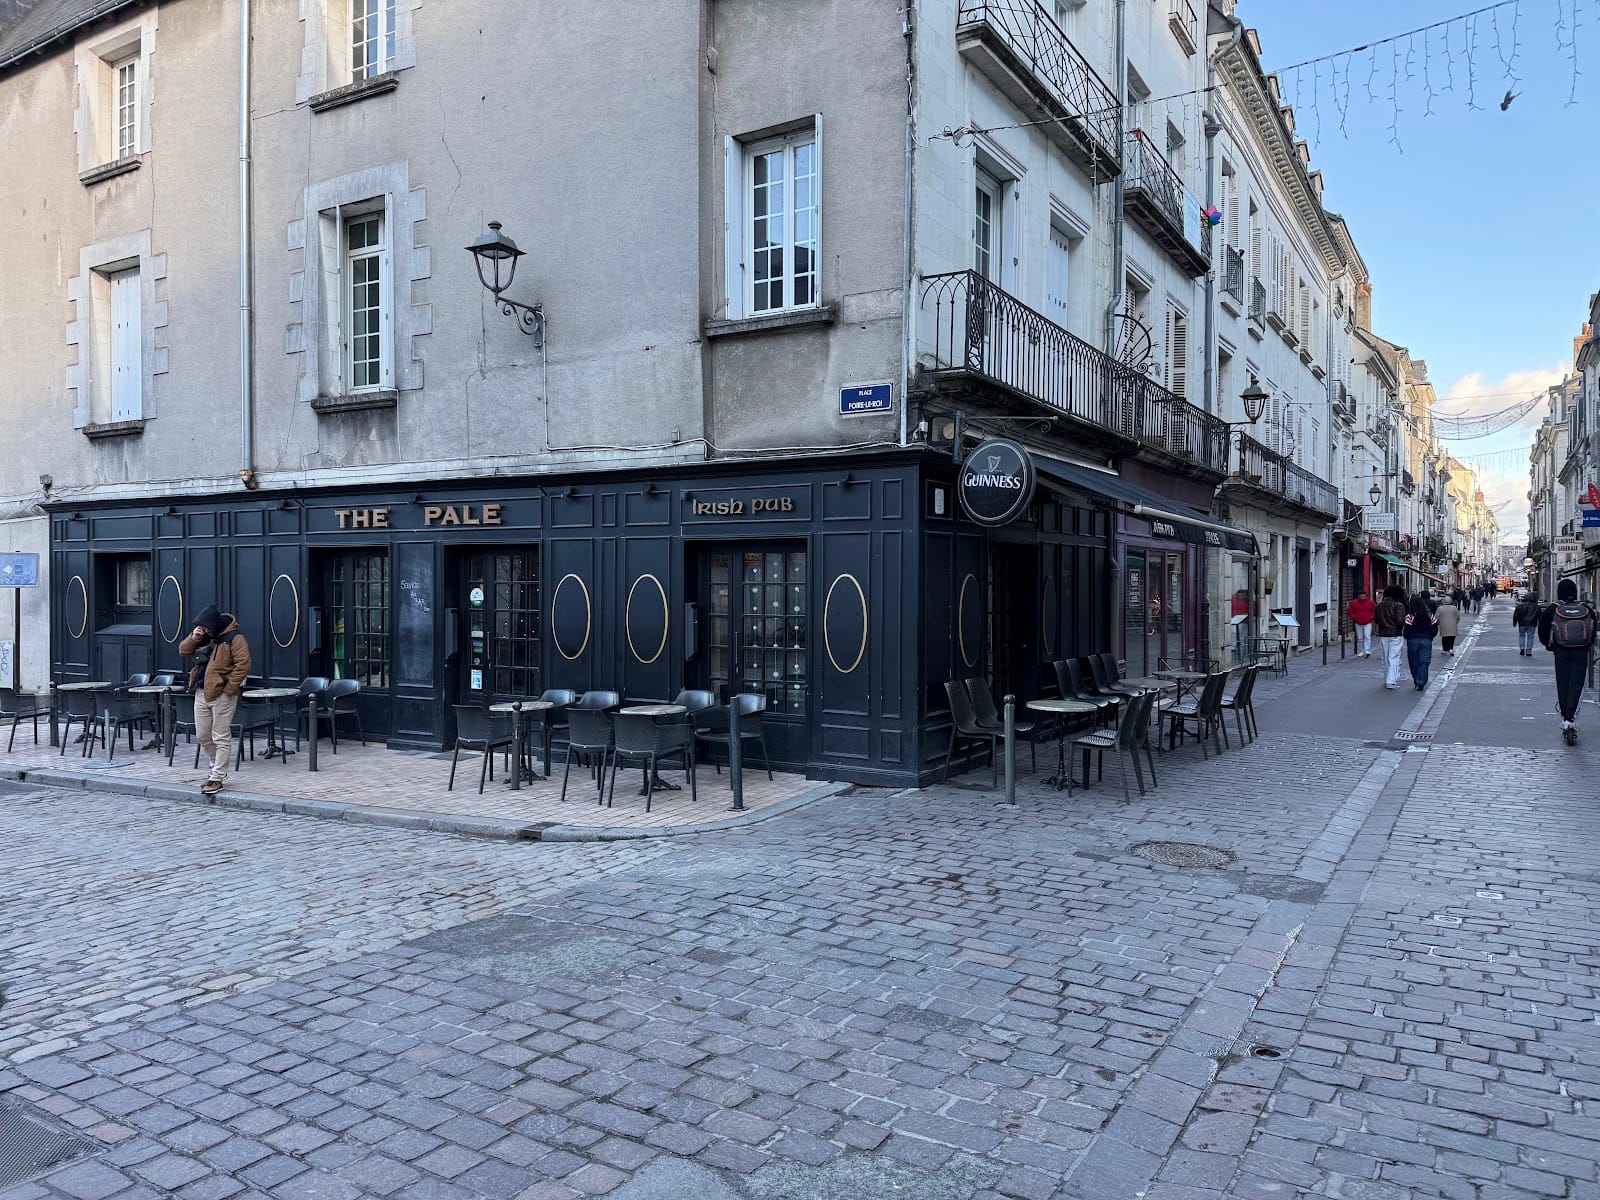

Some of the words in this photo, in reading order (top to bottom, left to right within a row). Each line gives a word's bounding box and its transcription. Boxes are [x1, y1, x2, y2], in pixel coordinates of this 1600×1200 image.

[848, 399, 883, 410] FOIRE-LE-ROI
[964, 472, 1021, 490] GUINNESS
[335, 508, 389, 529] THE
[423, 504, 502, 526] PALE
